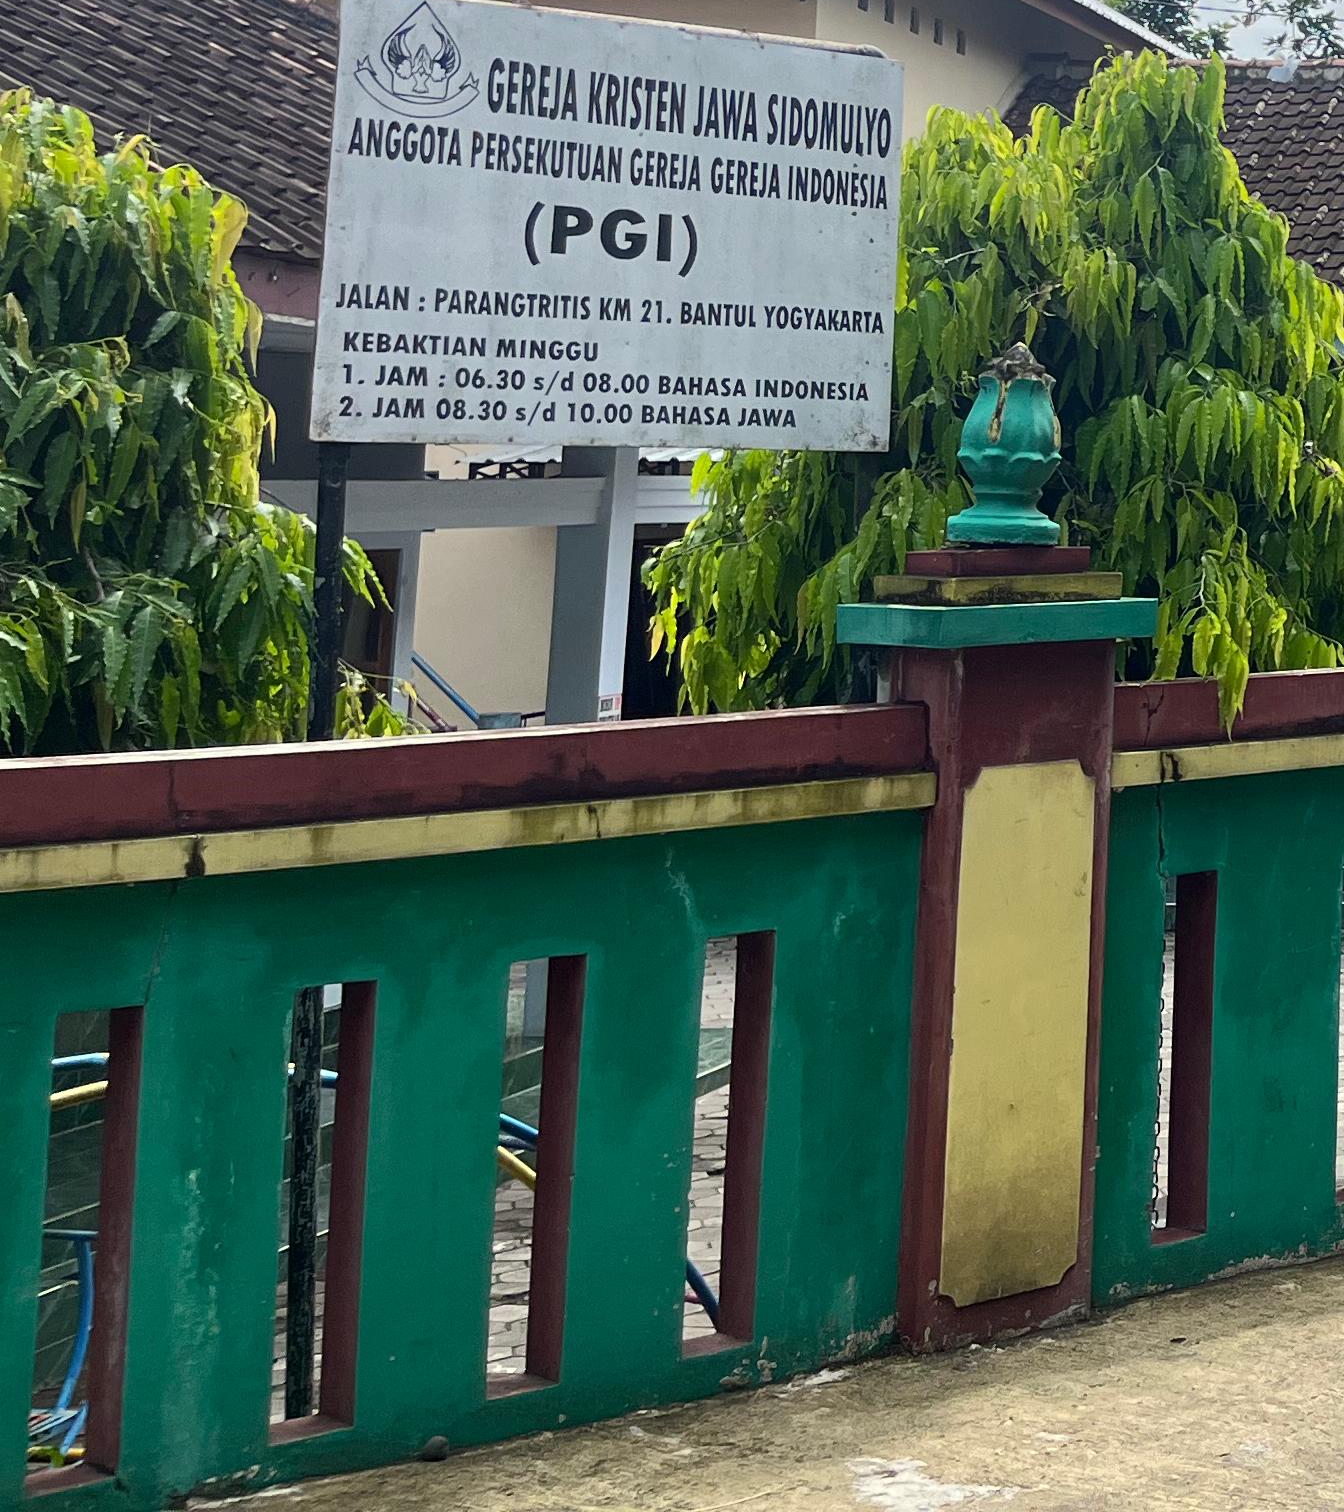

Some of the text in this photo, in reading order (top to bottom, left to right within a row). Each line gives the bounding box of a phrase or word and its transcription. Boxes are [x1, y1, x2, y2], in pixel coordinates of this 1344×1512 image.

[487, 57, 892, 159] GEREJA KRISTEN JAWA SIDOMULYO
[347, 117, 888, 210] ANGGOTA PERSEKUTUAN GEREJA GEREJA INDONESIA
[524, 200, 698, 278] (PGI)
[335, 283, 410, 312] JALAN
[434, 287, 591, 321] PARANGTRITIS
[599, 297, 632, 322] KM
[640, 299, 672, 324] 21.
[680, 301, 756, 328] BANTUL
[763, 305, 885, 334] YOGYAKARTA
[342, 331, 599, 362] KEBAKTIAN MINGGU
[342, 363, 365, 385] 1.
[374, 365, 429, 387] JAM
[455, 367, 526, 391] 06.30
[532, 370, 574, 396] s/d
[582, 372, 650, 394] 08.00
[657, 375, 747, 397] BAHASA
[755, 378, 869, 401] INDONESIA
[338, 395, 797, 428] 2. JAM 08.30 s/d 10.00 BAHASA JAWA
